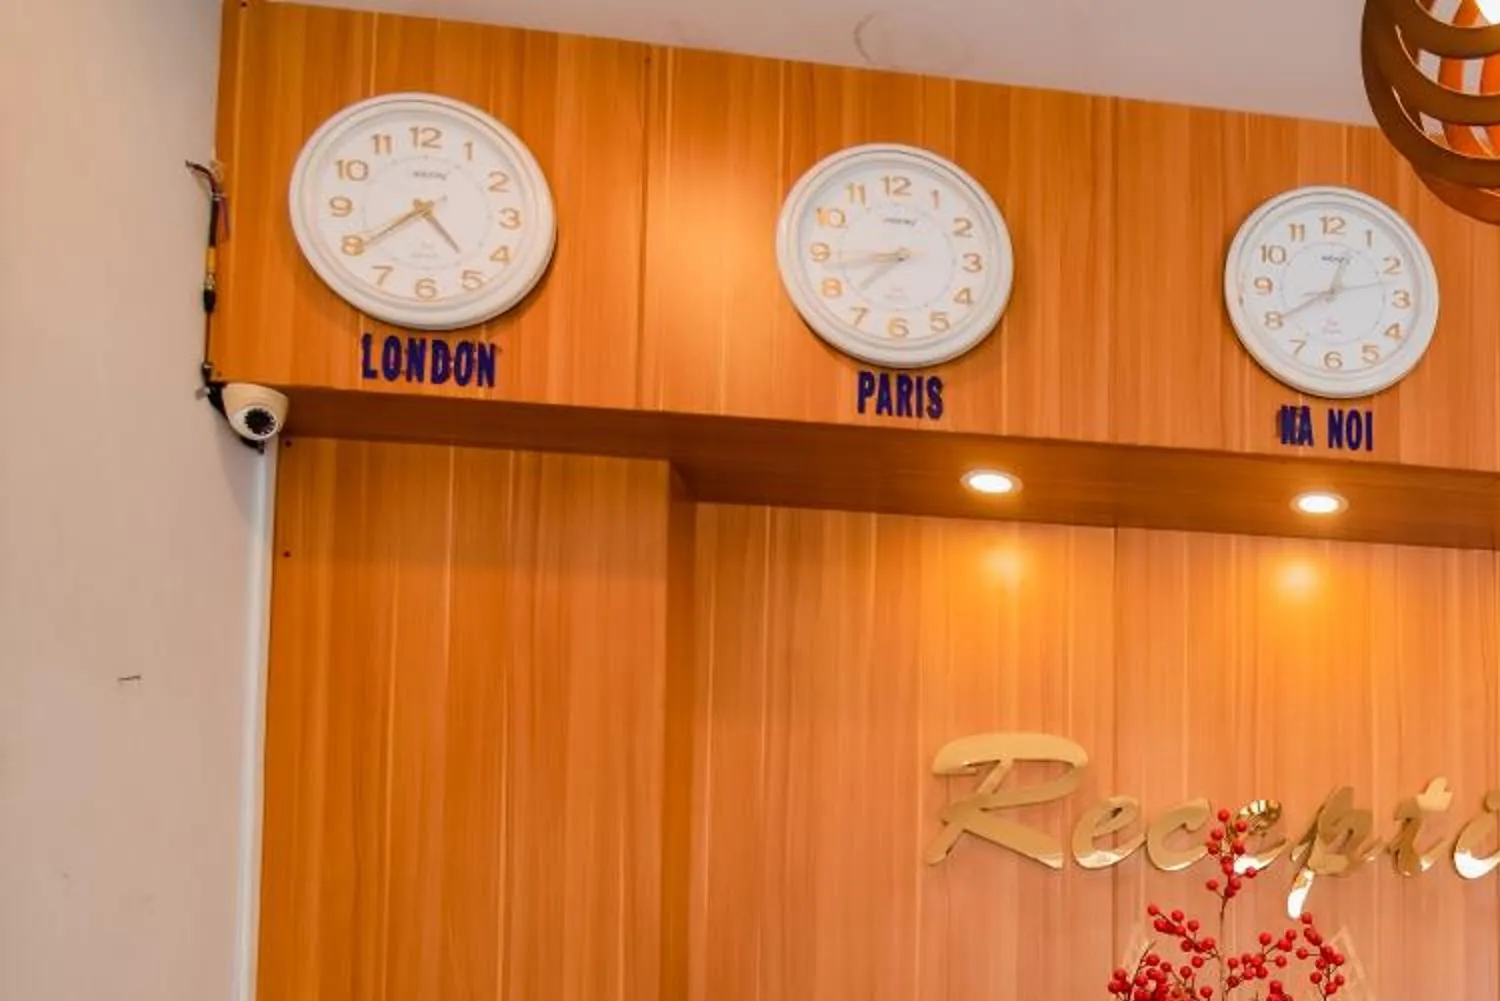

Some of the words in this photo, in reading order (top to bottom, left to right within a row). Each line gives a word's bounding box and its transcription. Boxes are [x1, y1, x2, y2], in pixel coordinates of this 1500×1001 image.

[372, 135, 392, 155] 11
[410, 127, 442, 148] 12
[336, 160, 368, 181] 10
[488, 172, 509, 192] 2
[880, 176, 912, 196] 12
[847, 183, 866, 205] 11
[329, 197, 352, 217] 9
[499, 209, 521, 229] 3
[816, 207, 846, 228] 10
[1319, 216, 1346, 235] 12
[952, 219, 973, 238] 2
[1288, 223, 1305, 242] 11
[342, 236, 364, 255] 8
[490, 245, 511, 264] 4
[811, 243, 830, 262] 9
[1260, 245, 1287, 264] 10
[962, 253, 982, 273] 3
[1383, 257, 1401, 275] 2
[372, 265, 392, 285] 7
[461, 270, 483, 291] 5
[415, 278, 437, 298] 6
[821, 278, 842, 298] 8
[1254, 276, 1273, 295] 9
[954, 288, 972, 306] 4
[1392, 290, 1410, 309] 3
[850, 307, 868, 326] 7
[930, 312, 950, 332] 5
[1264, 311, 1284, 330] 8
[888, 317, 909, 337] 6
[1385, 323, 1402, 340] 4
[1289, 340, 1306, 356] 7
[1361, 345, 1380, 365] 5
[361, 334, 497, 387] LONDON
[1324, 352, 1343, 371] 6
[857, 371, 943, 419] PARIS
[1327, 409, 1374, 451] NOI
